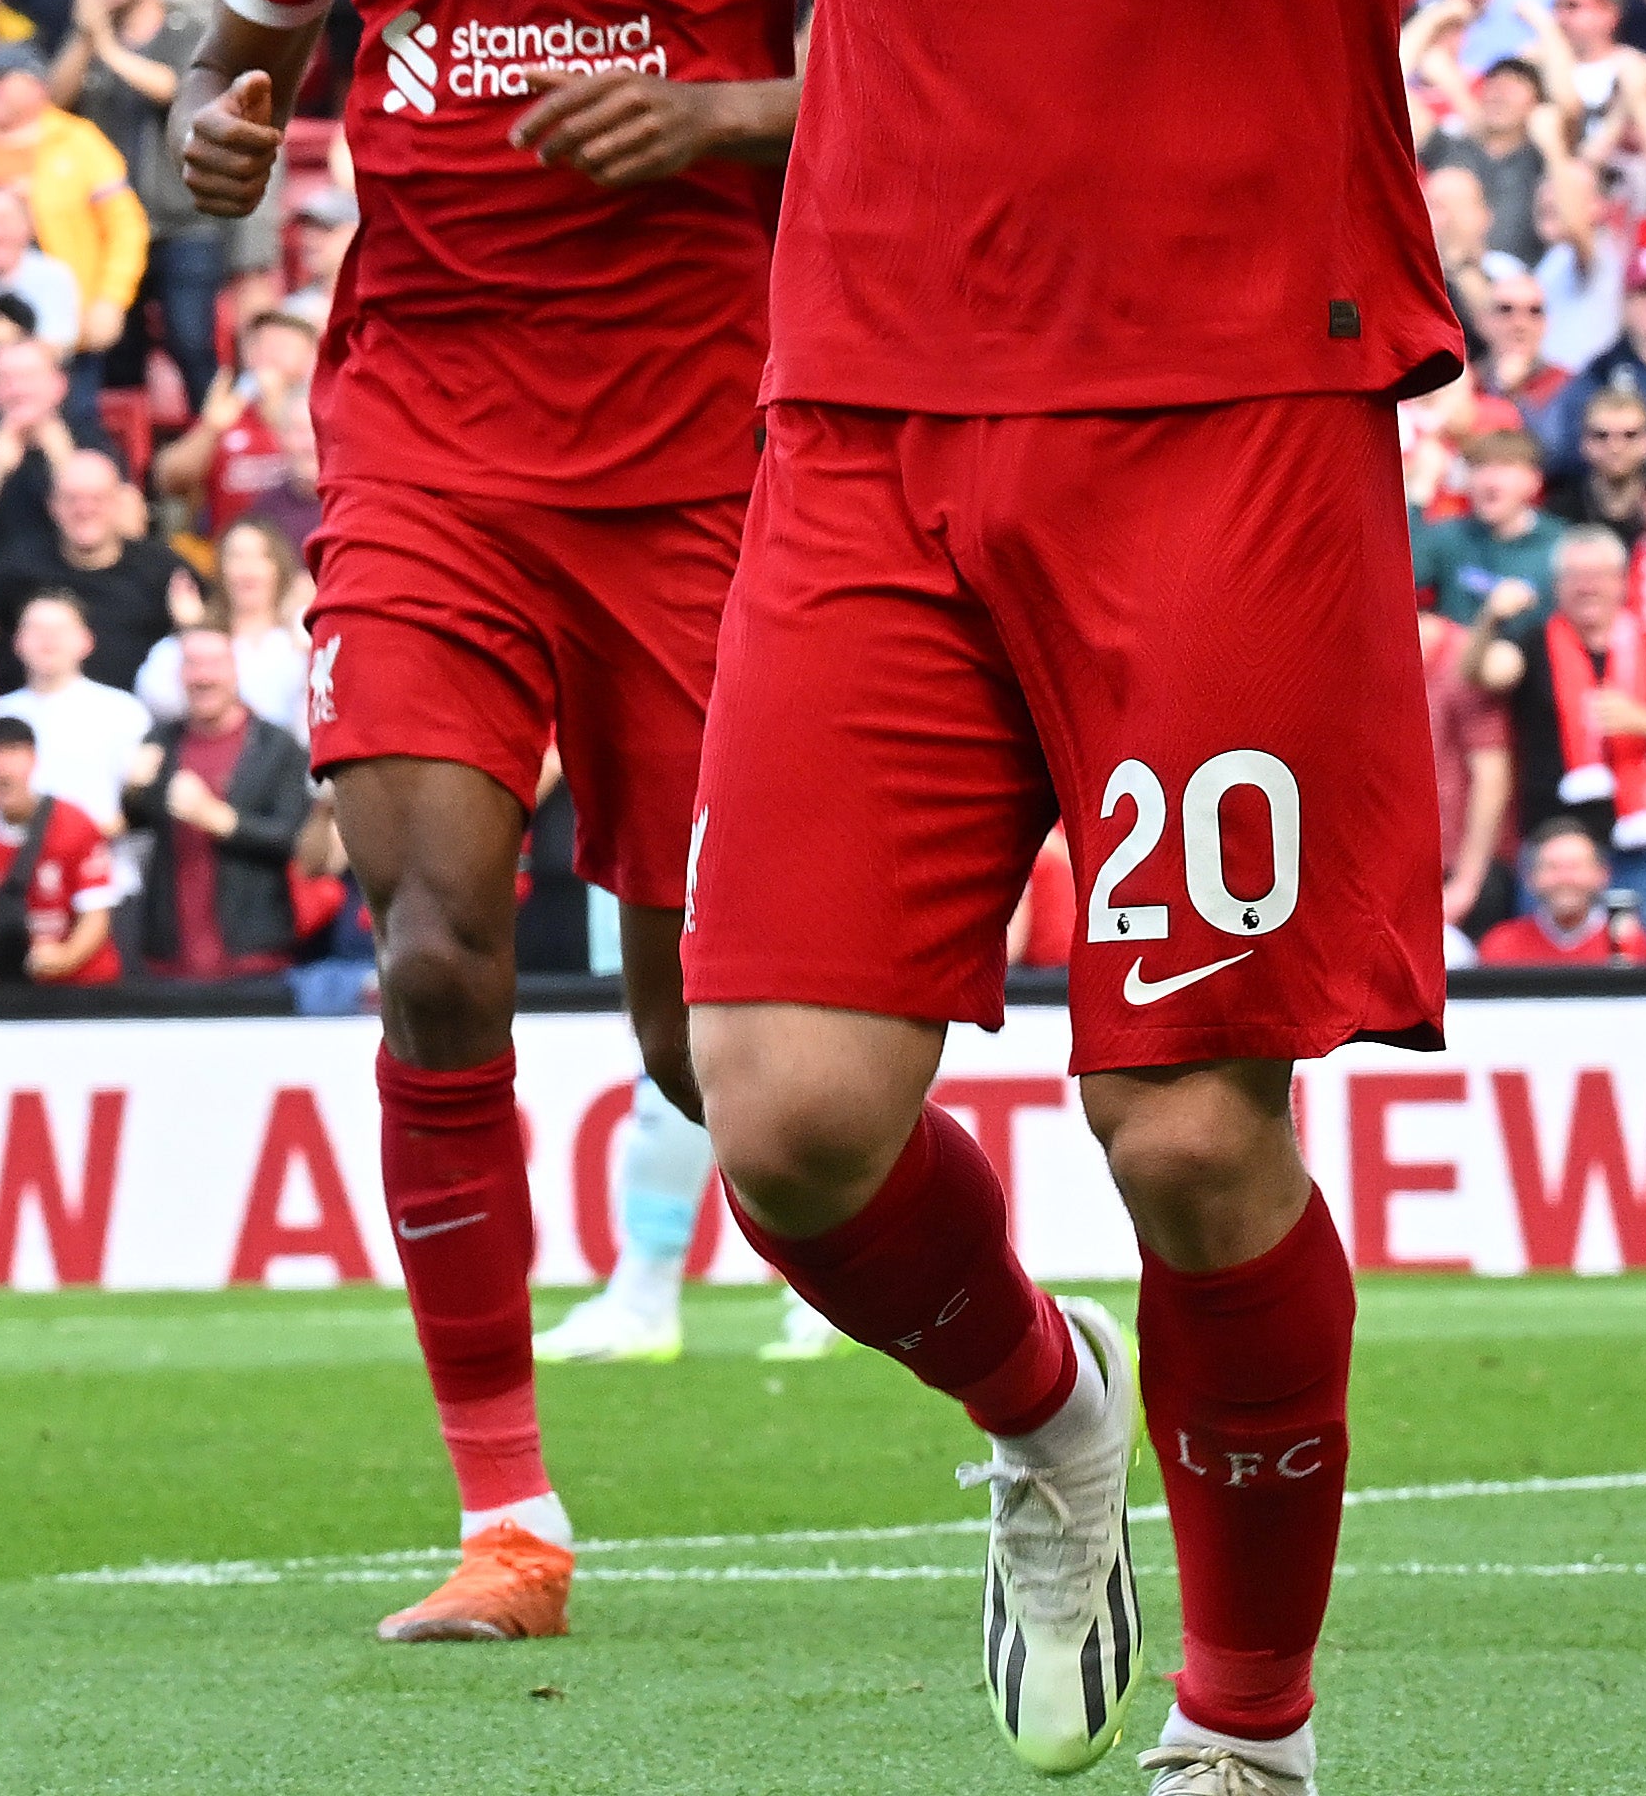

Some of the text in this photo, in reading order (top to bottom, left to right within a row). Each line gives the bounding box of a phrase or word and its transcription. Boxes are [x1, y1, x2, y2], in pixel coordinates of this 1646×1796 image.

[450, 14, 652, 60] standard
[1087, 749, 1301, 944] 20
[1175, 1428, 1323, 1488] LFC
